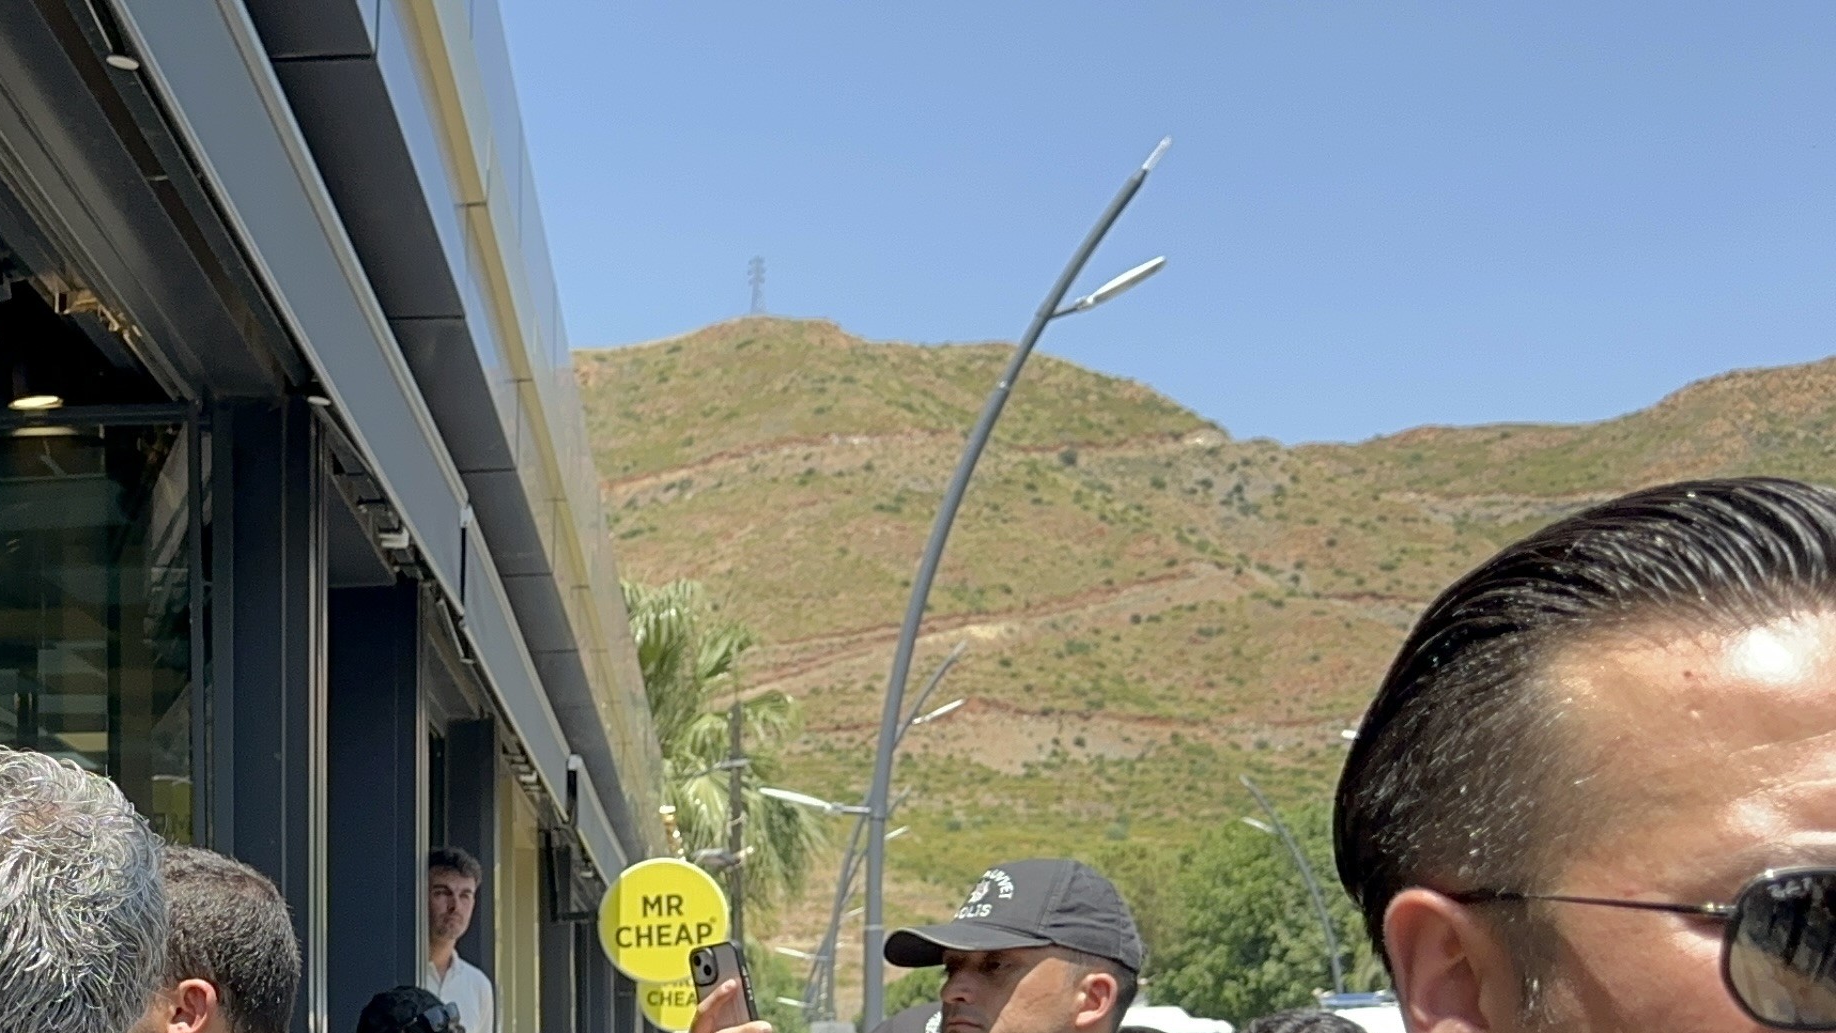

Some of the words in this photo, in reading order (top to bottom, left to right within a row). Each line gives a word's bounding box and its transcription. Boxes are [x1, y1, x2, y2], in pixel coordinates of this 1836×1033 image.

[642, 894, 684, 918] MR
[615, 922, 714, 948] CHEAP
[646, 990, 697, 1008] CHEA
